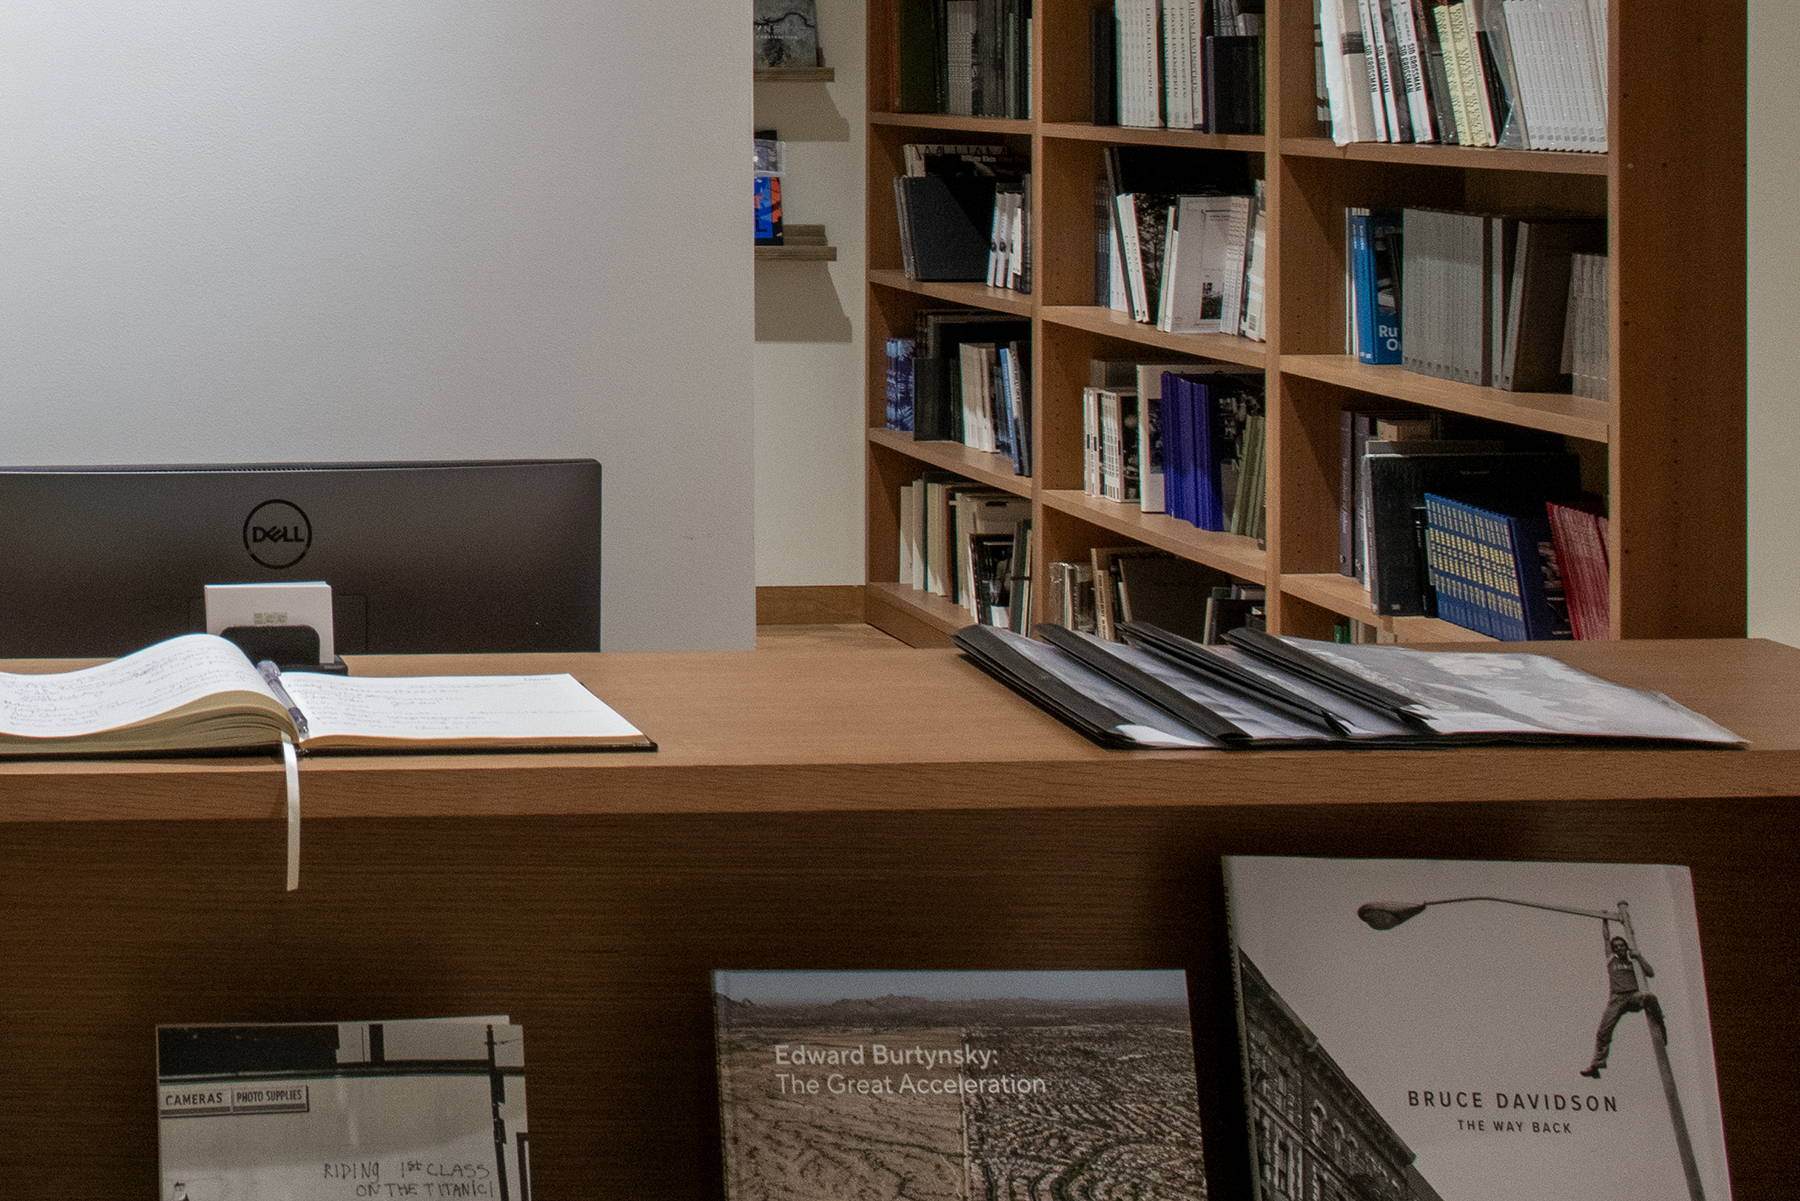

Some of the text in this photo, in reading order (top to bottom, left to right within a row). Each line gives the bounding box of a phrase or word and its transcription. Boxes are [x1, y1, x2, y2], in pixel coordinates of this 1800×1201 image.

[252, 525, 305, 543] DELL
[775, 1044, 999, 1070] Edward Burtynsky:
[776, 1073, 1047, 1095] The Great Acceleration
[165, 1089, 303, 1106] CAMERAS PHOTO SUPPLIES
[1407, 1090, 1618, 1112] BRUCE DAVIDSON
[1457, 1119, 1572, 1134] THE WAY BACK
[324, 1161, 380, 1185] RIDING
[426, 1162, 491, 1180] CLASS
[356, 1183, 381, 1198] ON
[384, 1182, 419, 1198] THE
